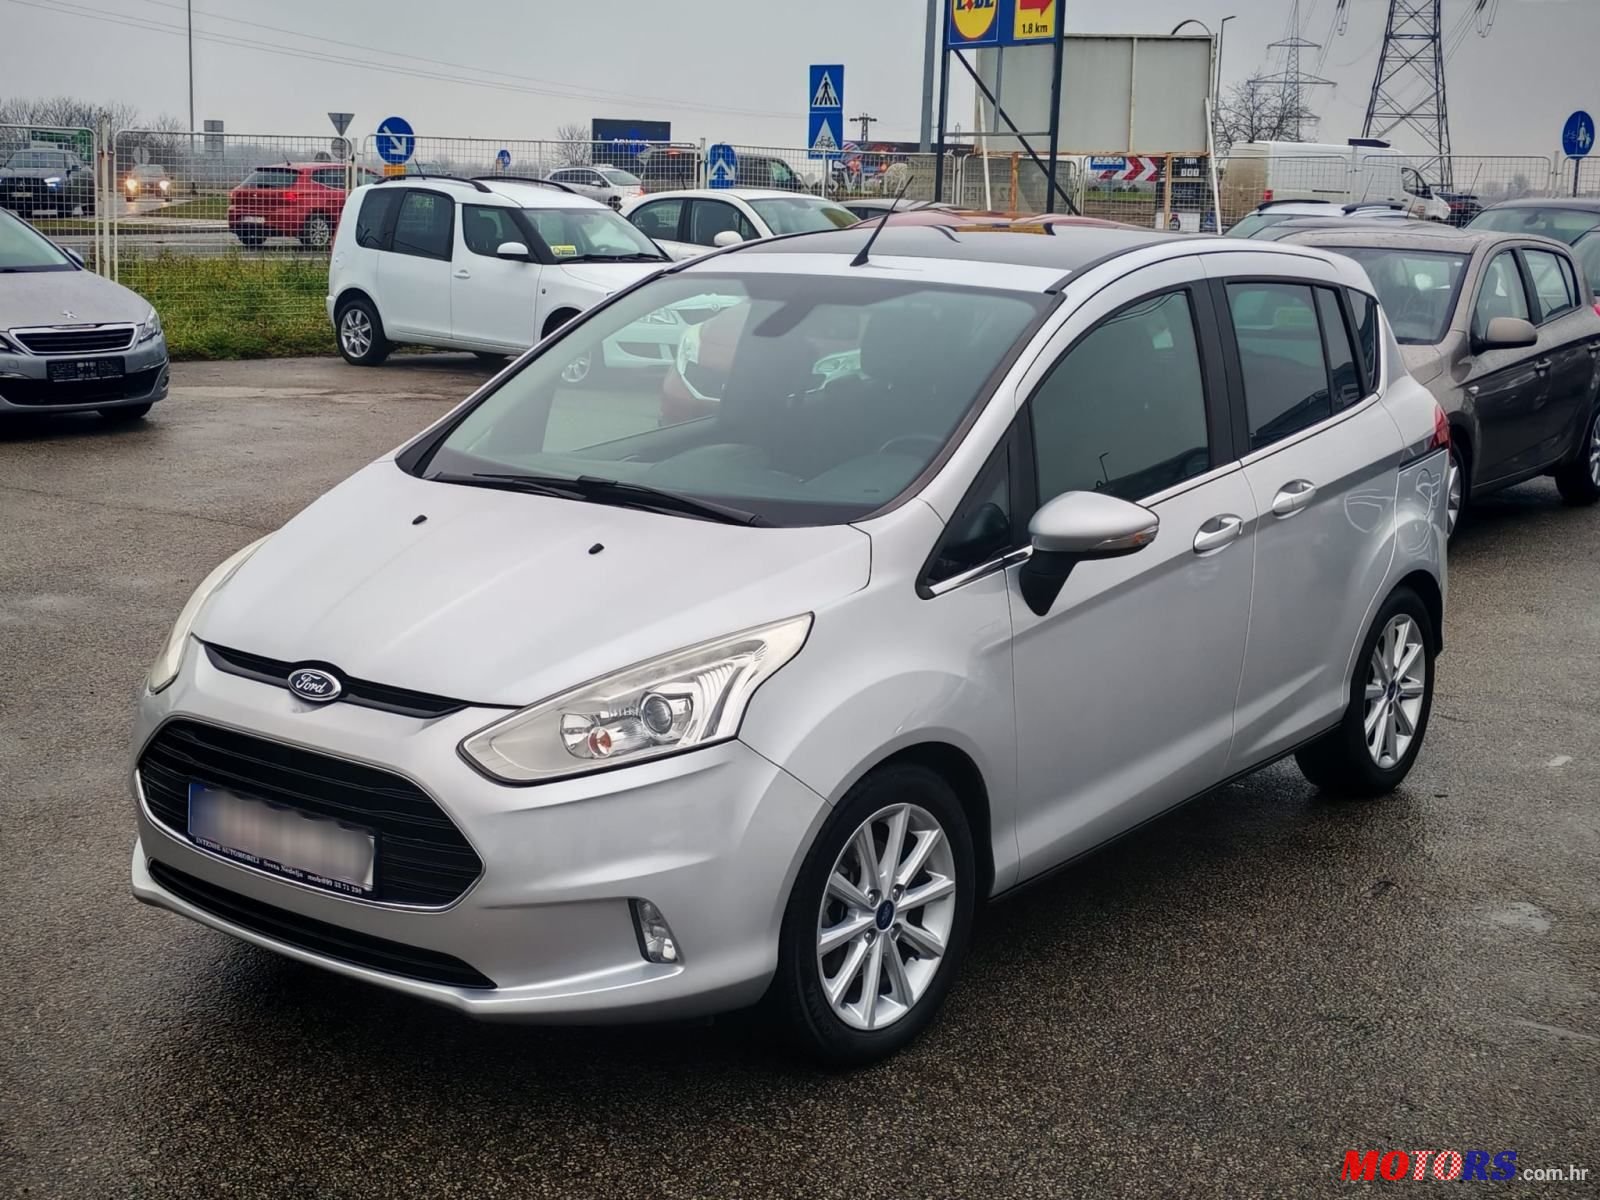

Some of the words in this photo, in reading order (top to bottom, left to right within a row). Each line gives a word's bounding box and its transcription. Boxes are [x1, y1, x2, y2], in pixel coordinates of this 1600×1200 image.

[1022, 23, 1033, 34] 1.8
[1035, 23, 1048, 33] km
[296, 673, 327, 693] Ford
